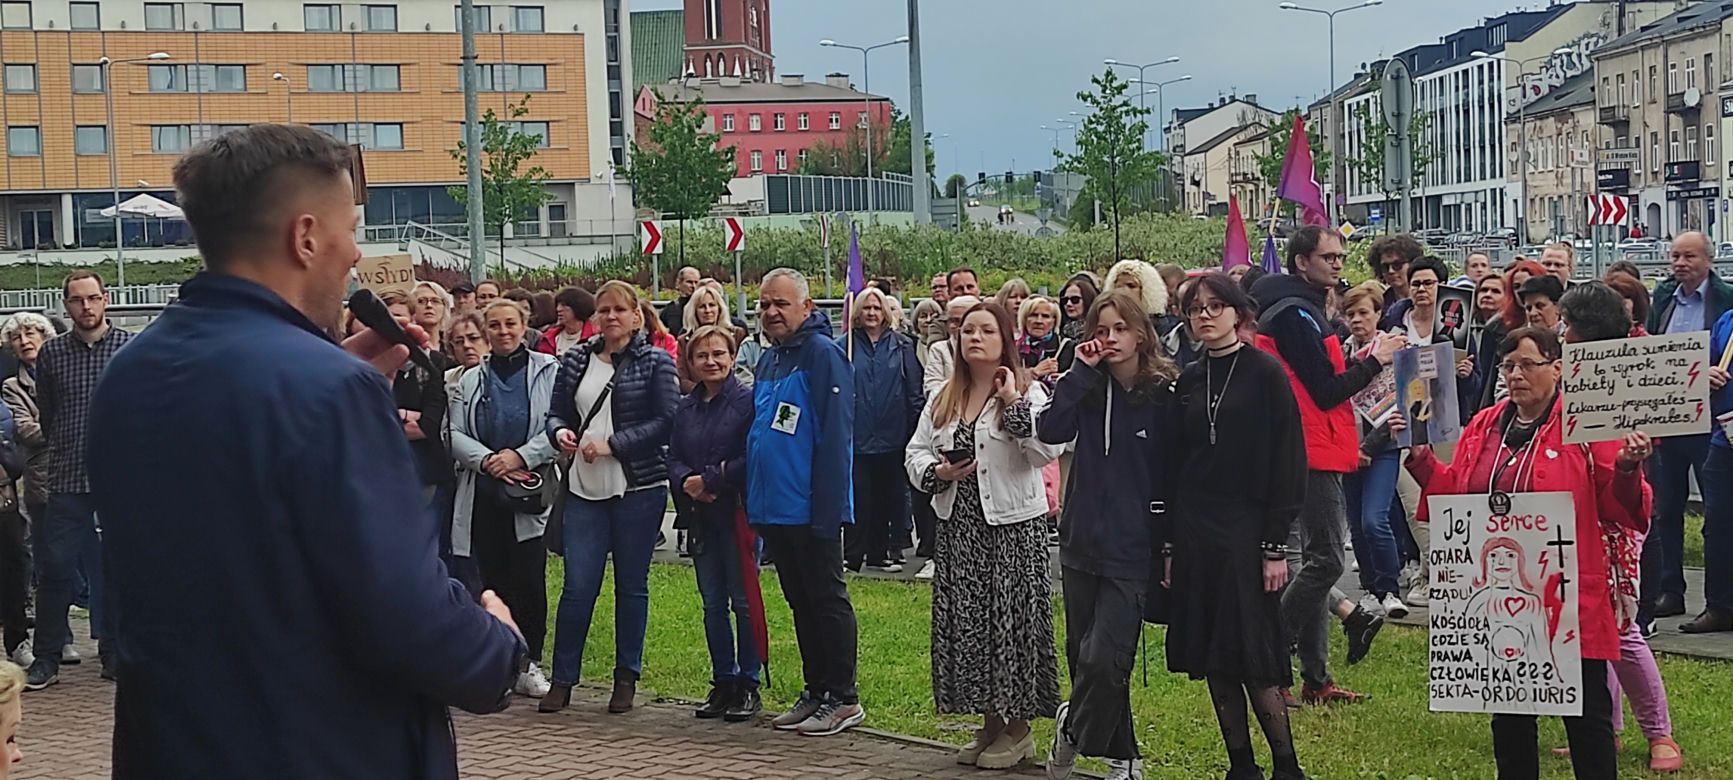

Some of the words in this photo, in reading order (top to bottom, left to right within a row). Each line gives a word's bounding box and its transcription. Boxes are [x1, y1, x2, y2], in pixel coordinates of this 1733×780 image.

[1569, 343, 1638, 364] Klauzula
[1594, 363, 1606, 376] to
[1611, 357, 1656, 379] wyrok
[1665, 358, 1688, 367] na
[1564, 376, 1615, 396] kobiety
[1627, 375, 1634, 388] i
[1638, 371, 1685, 387] dzieci.
[1443, 508, 1472, 545] Jej
[1486, 514, 1549, 533] serce
[1430, 546, 1474, 566] OFIARA
[1473, 633, 1490, 651] SĄ
[1431, 648, 1473, 663] PRAWA
[1532, 686, 1577, 704] IURIS
